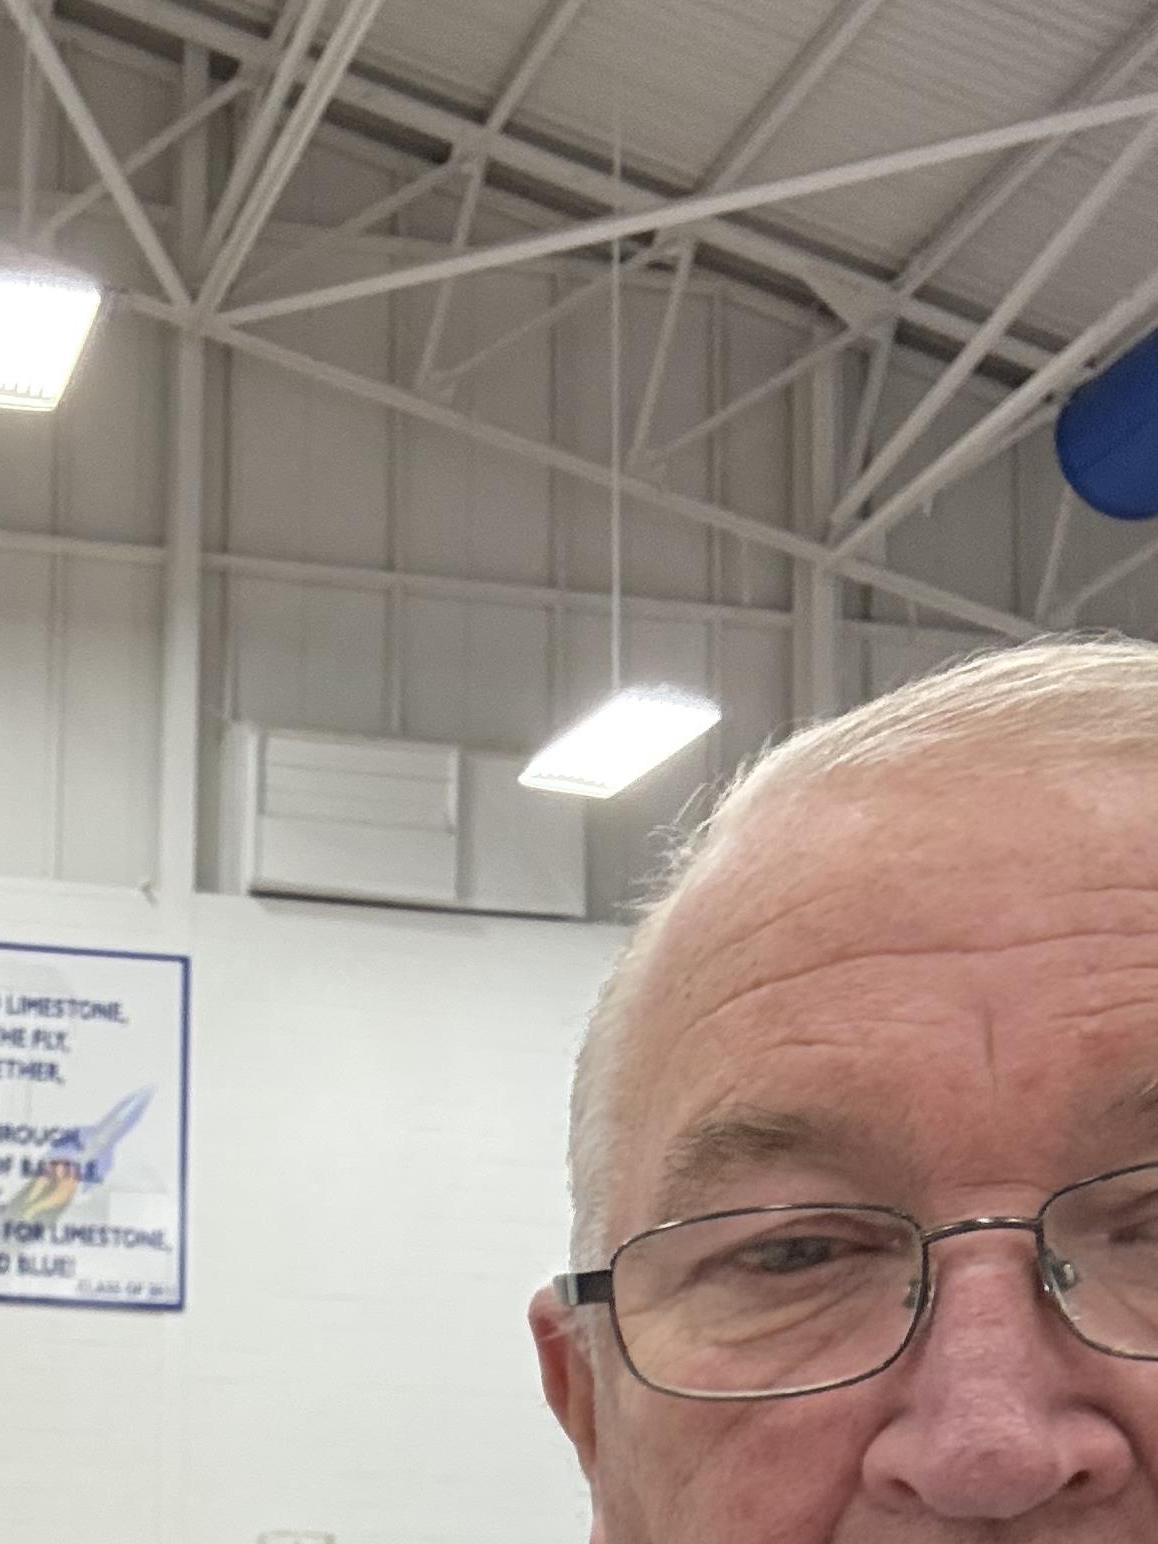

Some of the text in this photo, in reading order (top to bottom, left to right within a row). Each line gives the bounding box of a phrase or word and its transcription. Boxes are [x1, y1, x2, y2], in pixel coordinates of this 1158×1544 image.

[5, 996, 129, 1024] LIMESTONE,
[3, 1220, 43, 1243] FOR
[50, 1225, 172, 1252] LIMESTONE,
